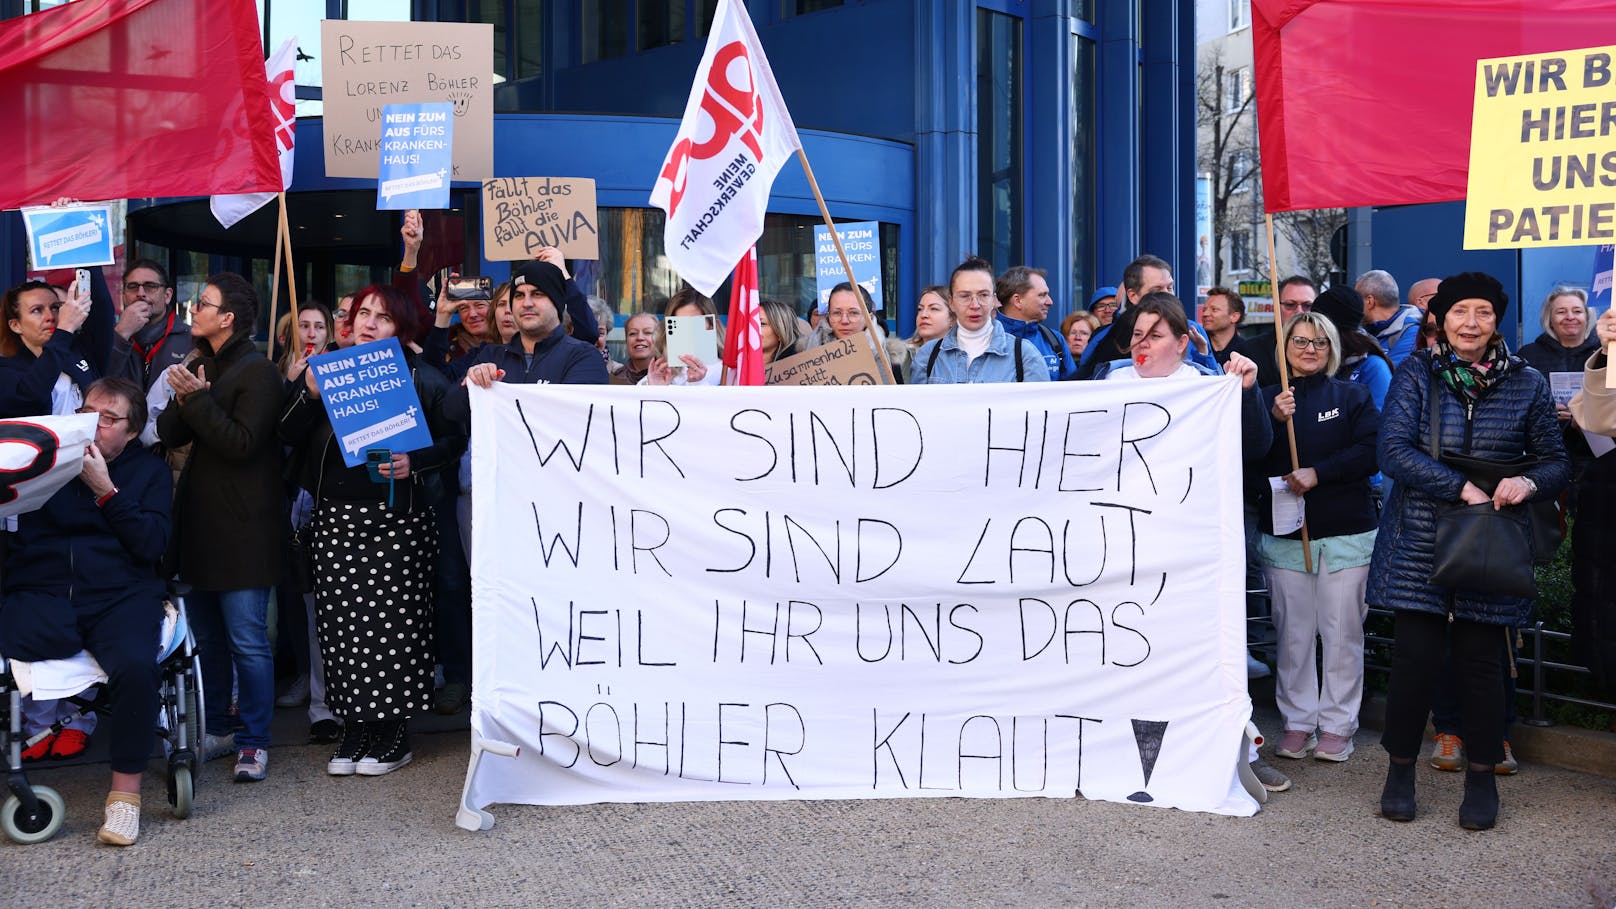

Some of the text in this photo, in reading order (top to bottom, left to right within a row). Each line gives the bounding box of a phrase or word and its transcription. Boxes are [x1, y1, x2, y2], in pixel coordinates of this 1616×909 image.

[339, 35, 463, 66] RETTET DAS
[346, 72, 479, 97] LORENZ BÖHLER
[1484, 53, 1616, 98] WIR B
[385, 125, 445, 137] AUS FÜRS
[386, 112, 446, 123] NEIN ZUM
[333, 133, 383, 156] KRANK
[385, 140, 448, 151] KRANKEN-
[384, 154, 420, 165] HAUS!
[482, 178, 572, 200] Fällt das
[496, 196, 554, 225] Böhler
[1488, 203, 1615, 243] PATIE
[494, 212, 559, 247] fällt die
[524, 210, 596, 255] AUVA
[819, 230, 873, 241] NEN ZUM
[844, 241, 873, 251] FÜRS
[316, 348, 394, 375] NEIN ZUM
[764, 339, 857, 385] Zusammenhalt
[324, 363, 398, 390] AUS FÜRS
[327, 377, 407, 404] KRANKEN-
[333, 398, 380, 419] HAUS!
[348, 433, 371, 446] RETTET
[370, 428, 384, 438] DAS
[515, 398, 1193, 504] WIR SIND HIER,
[532, 501, 1167, 605] WIR SIND LAUT,
[531, 597, 1151, 671] WEIL IHR UNS DAS
[538, 683, 1170, 803] BÖHLER KLAUT!
